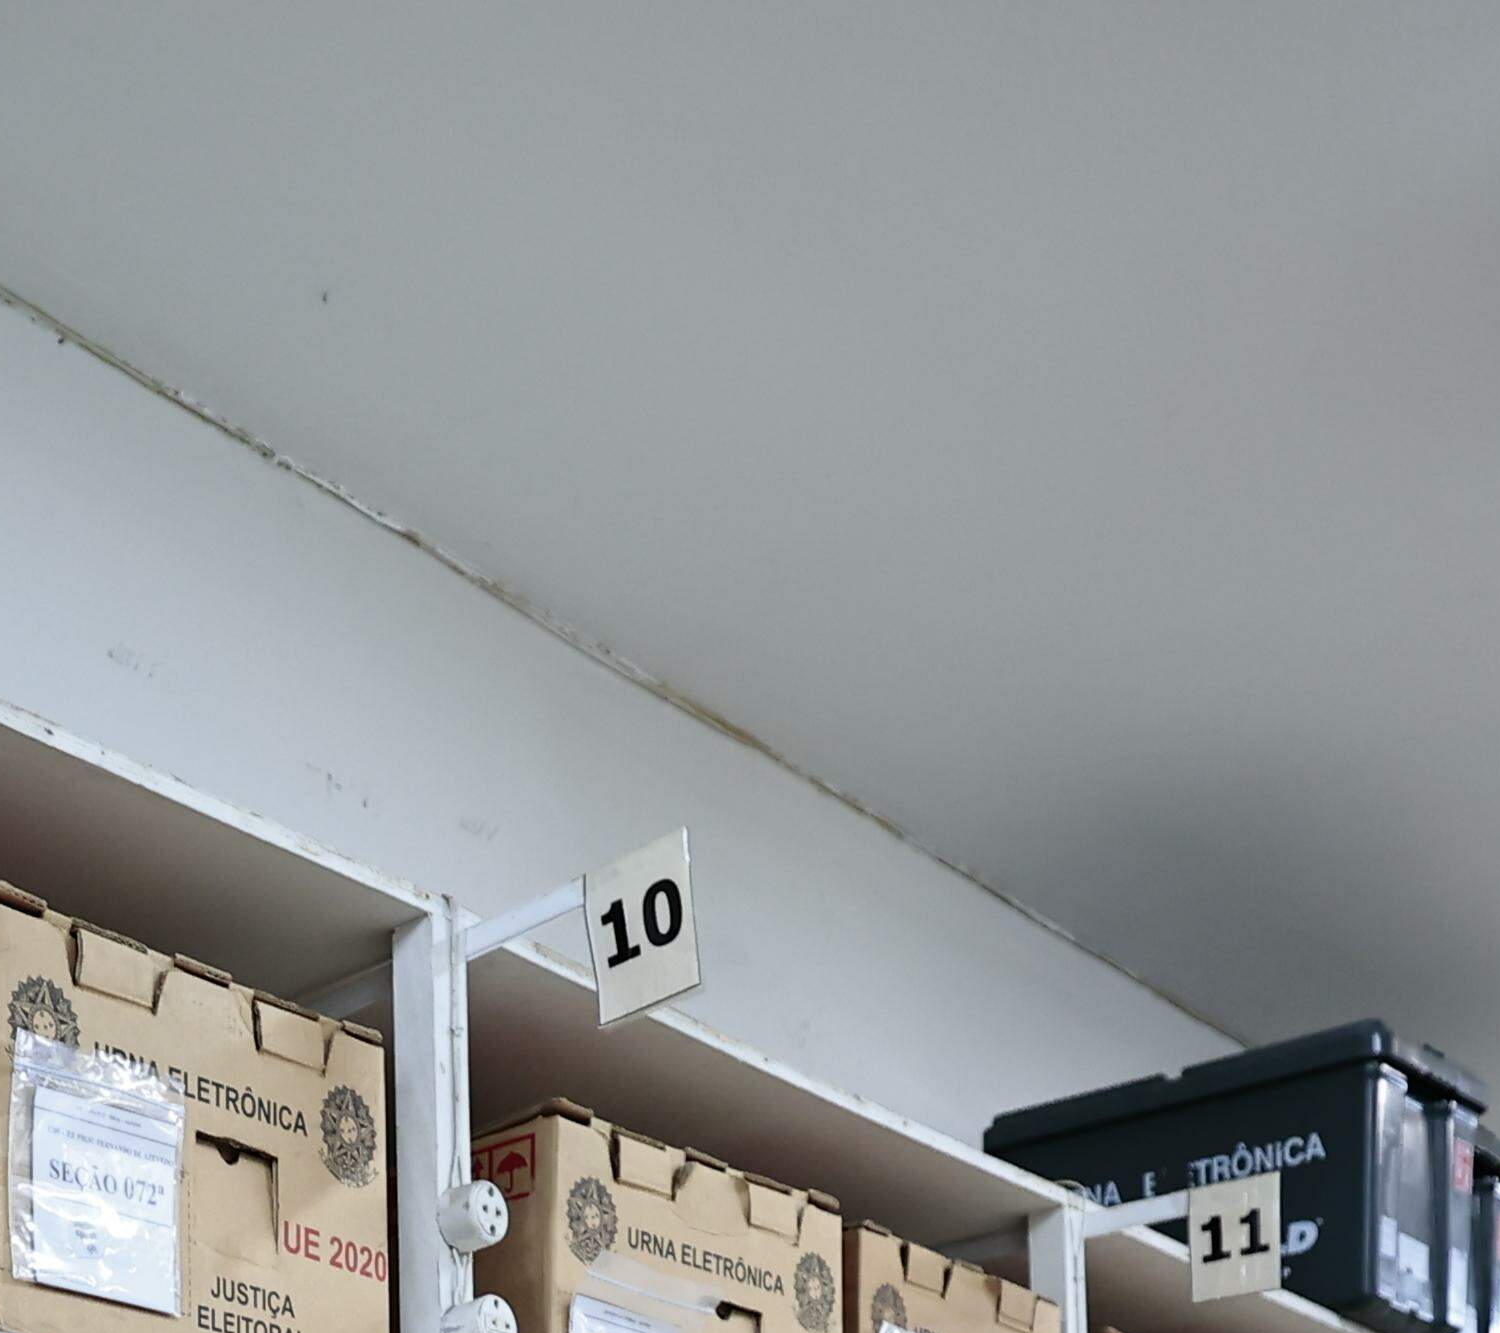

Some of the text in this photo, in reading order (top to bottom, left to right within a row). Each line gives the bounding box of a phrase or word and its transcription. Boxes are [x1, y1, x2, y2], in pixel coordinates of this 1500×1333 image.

[599, 878, 684, 969] 10
[168, 1066, 308, 1137] ELETRÔNICA
[48, 1158, 165, 1206] SEÇÃO 072ª
[284, 1220, 388, 1282] UE 2020
[628, 1226, 784, 1296] URNA ELETRÔNICA
[1199, 1208, 1272, 1262] 11
